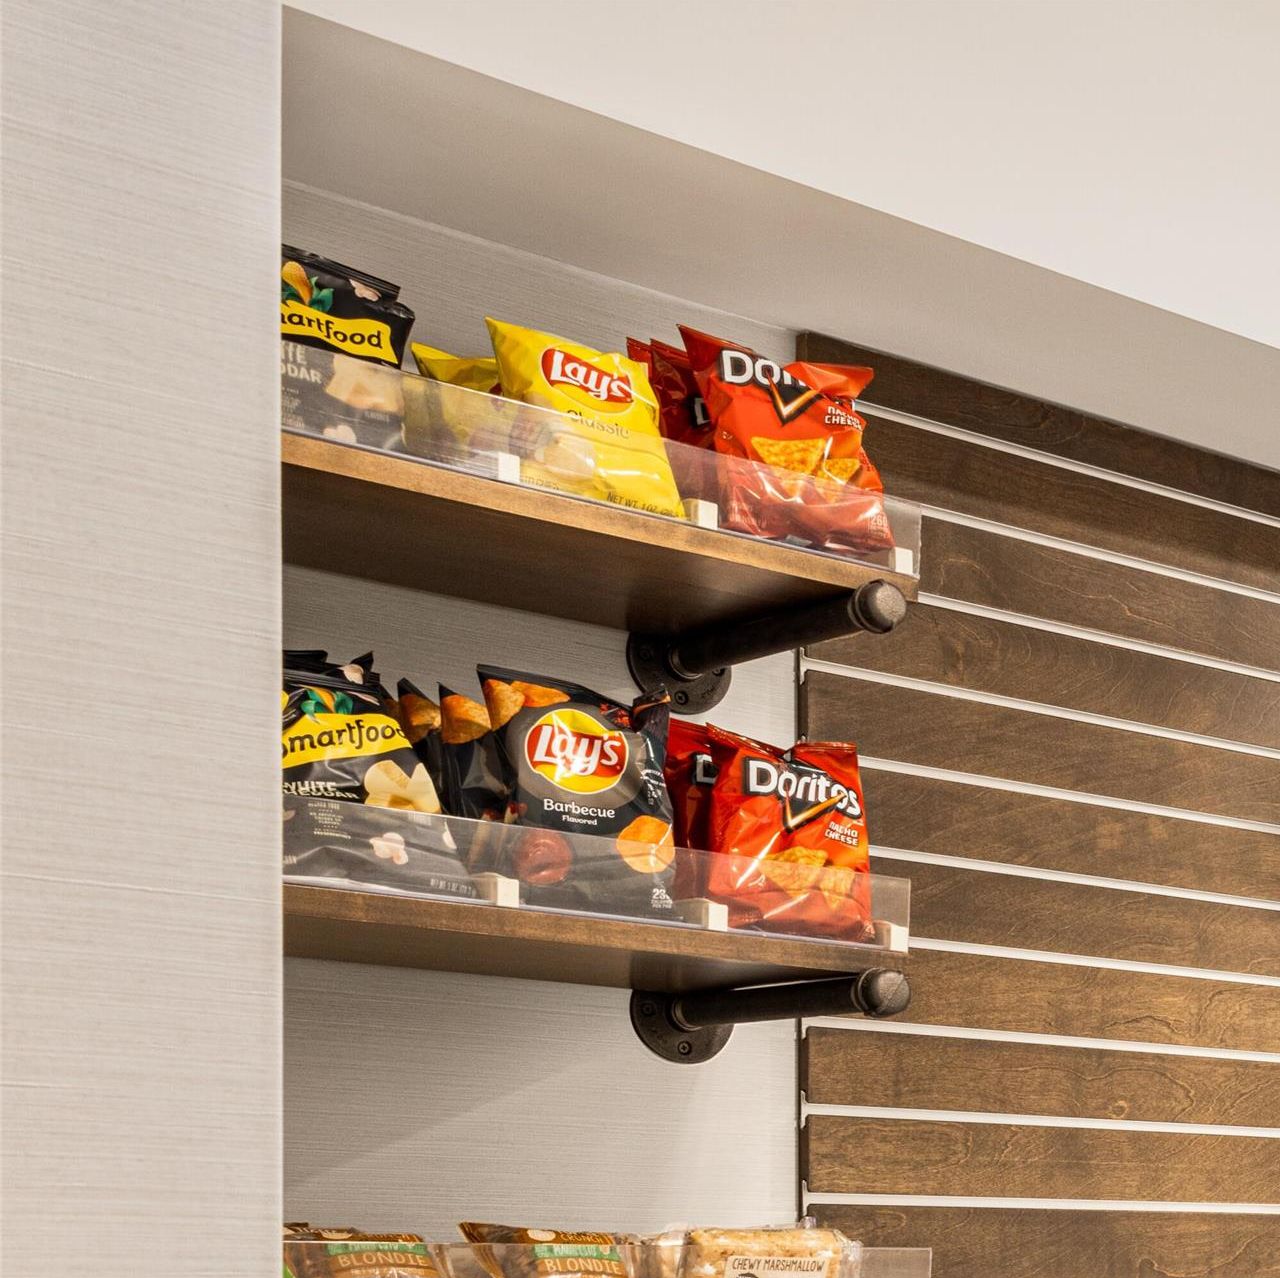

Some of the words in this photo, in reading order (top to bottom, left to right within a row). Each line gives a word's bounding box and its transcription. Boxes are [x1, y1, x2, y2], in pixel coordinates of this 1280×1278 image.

[281, 312, 383, 350] artfood
[551, 350, 634, 403] Lay's
[533, 725, 621, 776] Lay's
[748, 759, 863, 820] Doritos
[543, 798, 616, 819] Barbecue
[562, 814, 598, 826] Flavored
[825, 829, 859, 847] CHEESE
[338, 1252, 429, 1267] BLONDIE
[544, 1258, 622, 1274] BLONDIE
[732, 1258, 762, 1271] CHEWY
[763, 1259, 825, 1272] MARSHMALLOW
